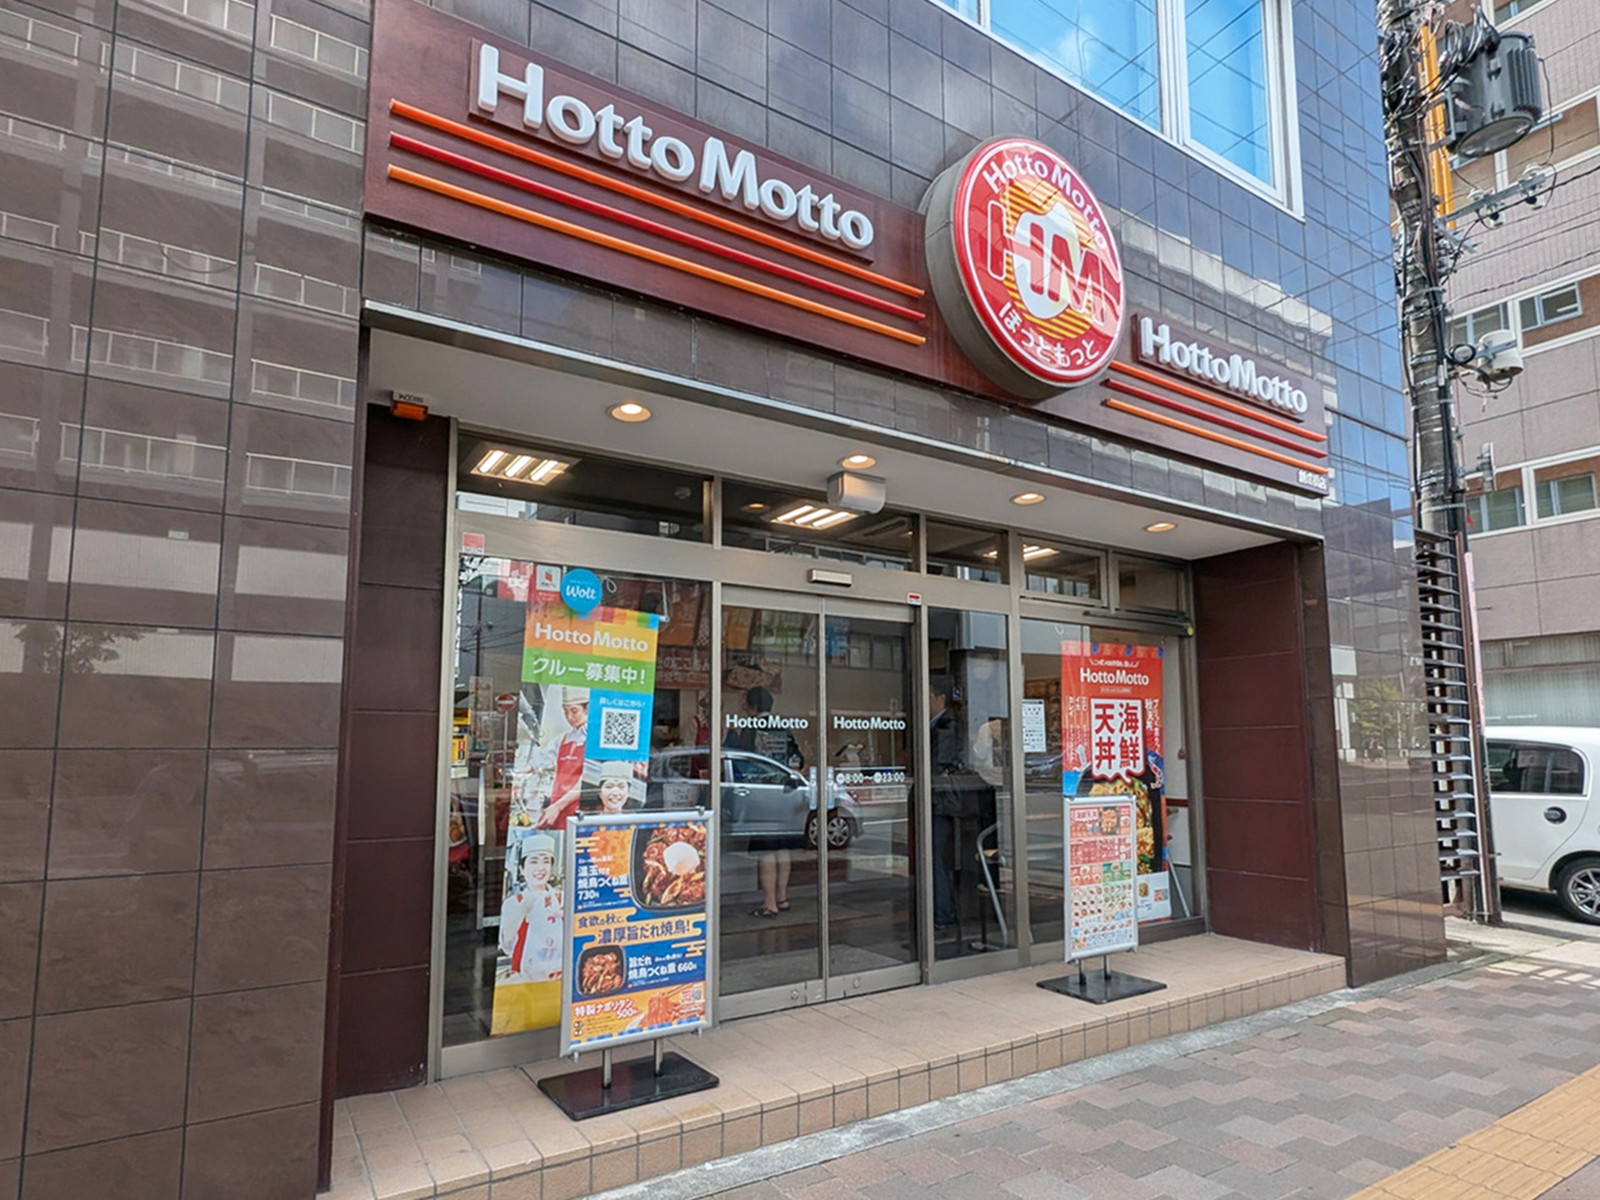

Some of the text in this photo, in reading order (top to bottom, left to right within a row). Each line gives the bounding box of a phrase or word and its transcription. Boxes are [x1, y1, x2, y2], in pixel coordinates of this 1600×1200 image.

[999, 300, 1099, 370] ほっともっと
[566, 585, 597, 601] Wolt
